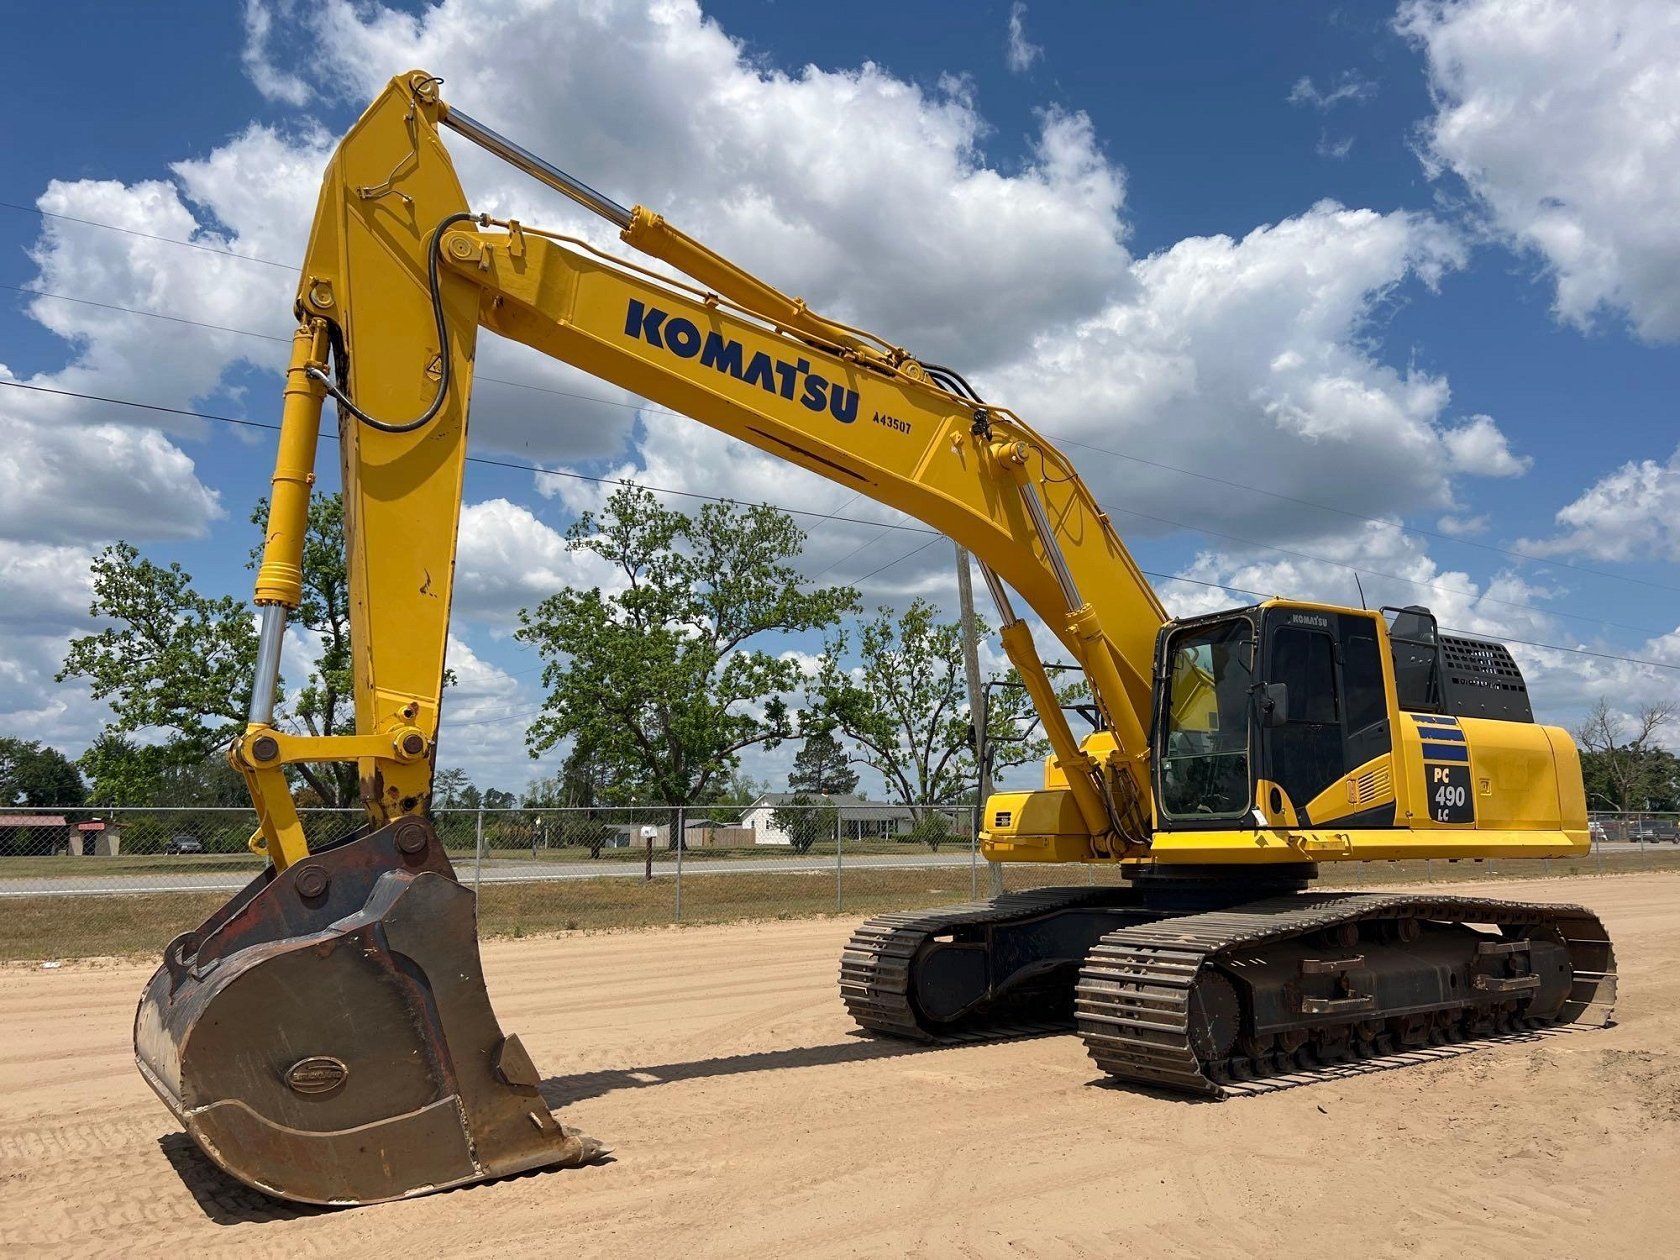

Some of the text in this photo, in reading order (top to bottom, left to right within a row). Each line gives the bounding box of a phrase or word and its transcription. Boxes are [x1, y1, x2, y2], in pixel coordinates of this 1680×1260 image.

[624, 298, 859, 424] KOMATSU
[872, 411, 911, 434] A43507
[1292, 614, 1328, 627] KOMATSU
[1433, 767, 1450, 783] PC
[1435, 785, 1465, 807] 490
[1437, 808, 1449, 821] LC
